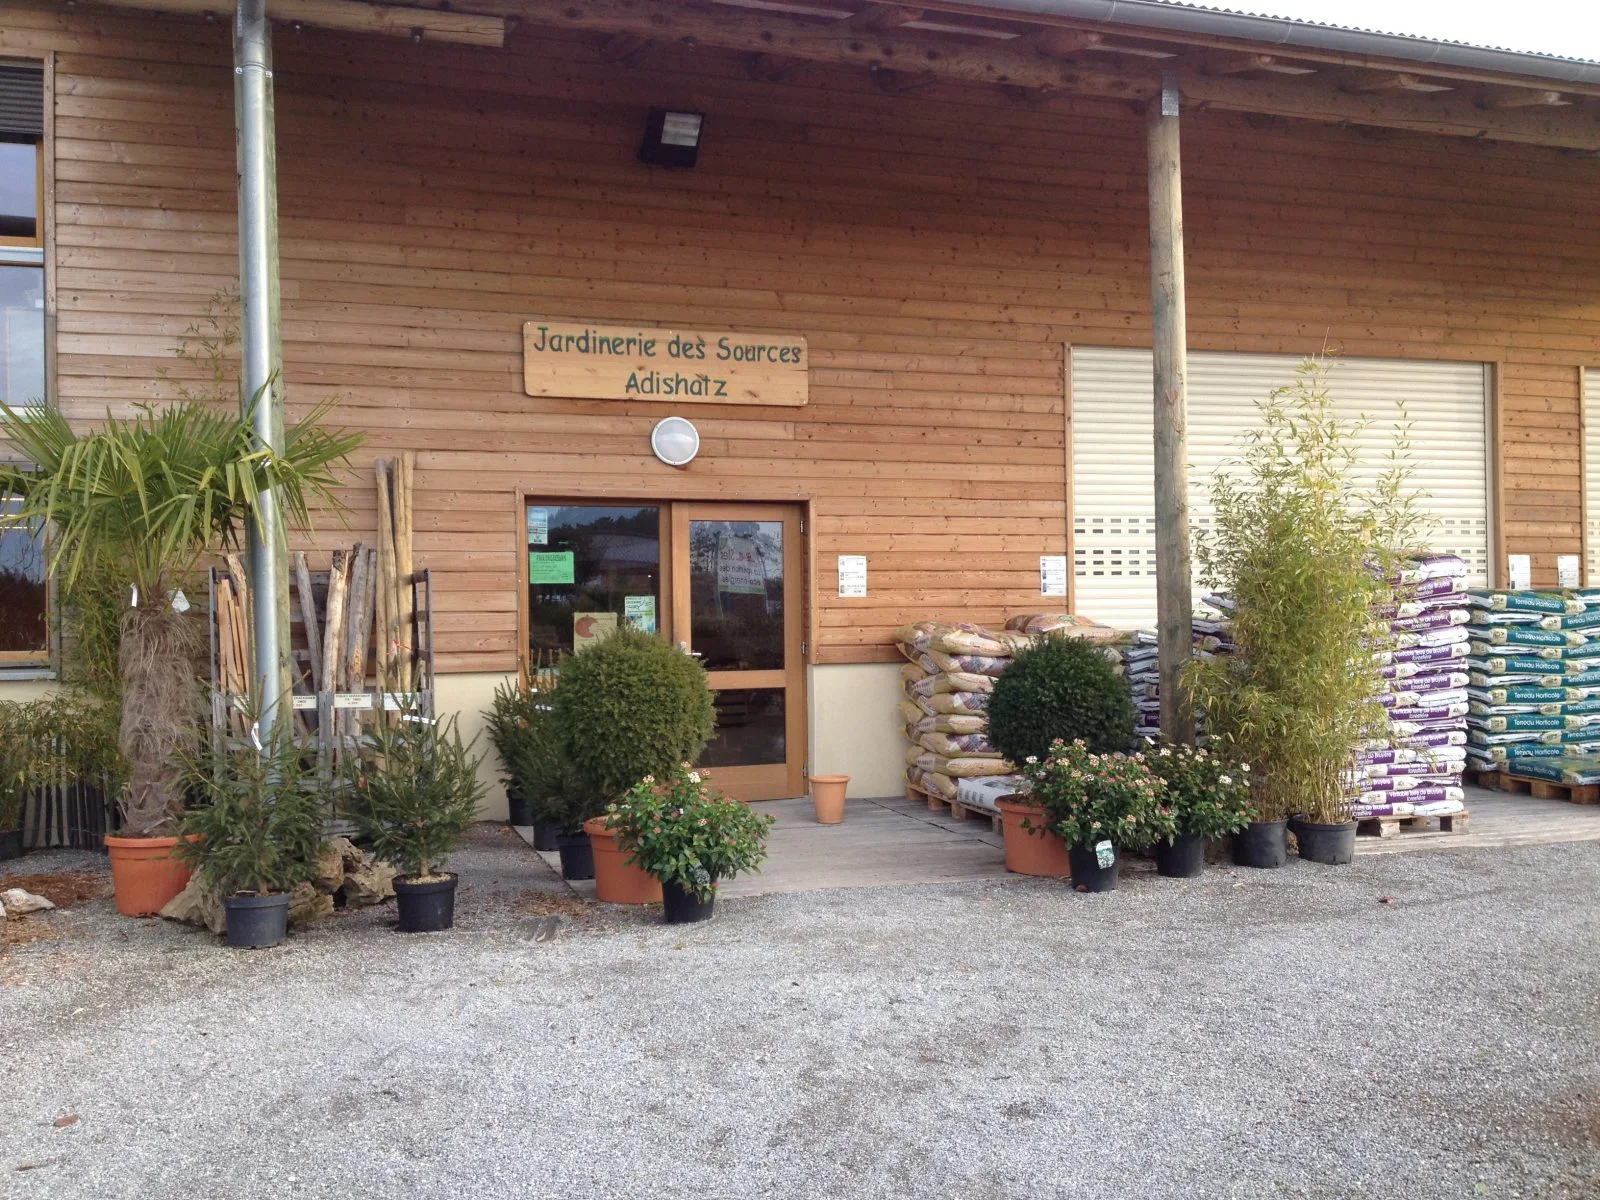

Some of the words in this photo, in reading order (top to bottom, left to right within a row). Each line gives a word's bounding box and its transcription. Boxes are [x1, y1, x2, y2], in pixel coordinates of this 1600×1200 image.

[534, 327, 656, 358] Jardinerie
[668, 334, 705, 360] des
[716, 337, 801, 364] Sources
[625, 371, 727, 397] Adishatz
[1514, 661, 1535, 669] Terreau
[1535, 662, 1560, 670] Horticole
[1514, 692, 1535, 700] Terreau
[1514, 719, 1535, 727] Terreau
[1514, 748, 1534, 756] Terreau
